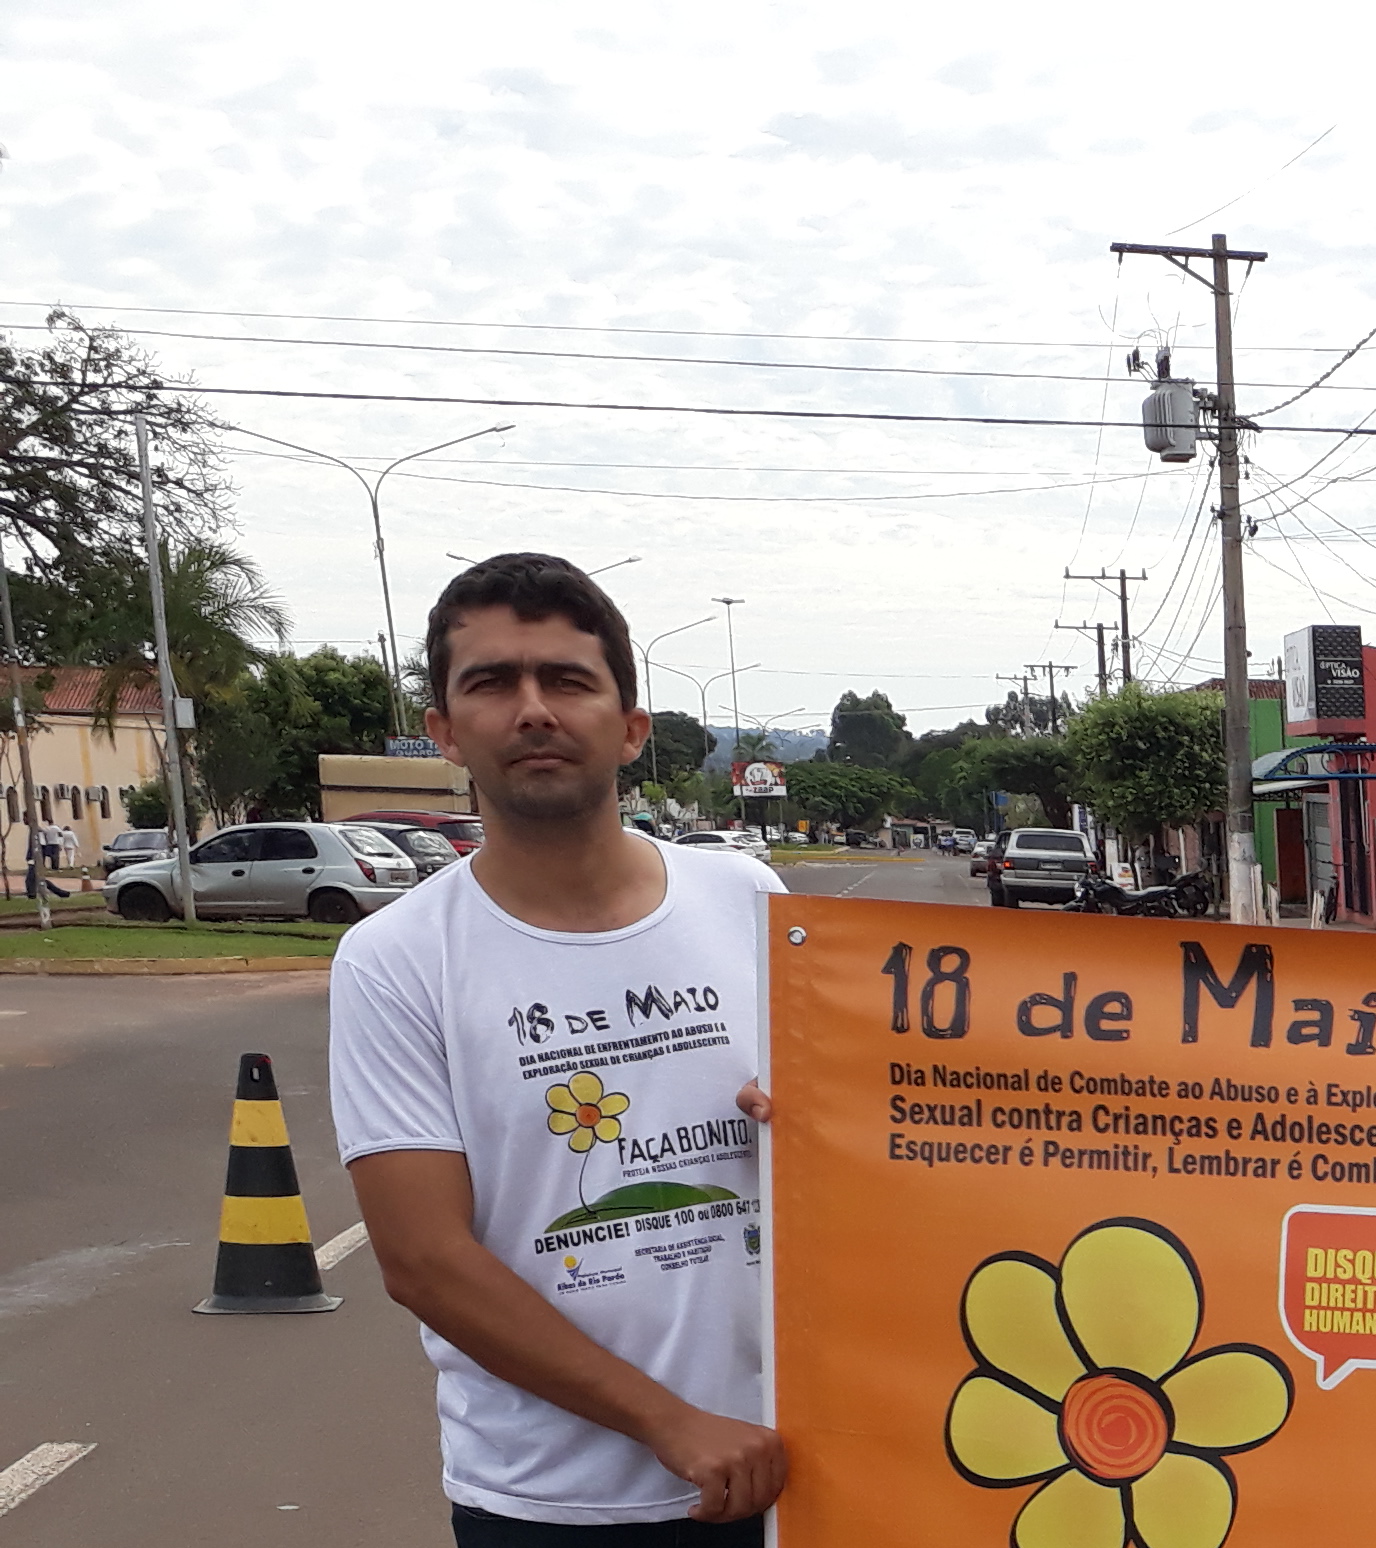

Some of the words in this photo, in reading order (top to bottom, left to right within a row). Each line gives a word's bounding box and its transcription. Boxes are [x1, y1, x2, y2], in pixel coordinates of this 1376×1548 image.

[508, 1003, 555, 1046] 18
[564, 1010, 610, 1034] DE
[626, 985, 719, 1027] MAIO
[881, 941, 970, 1039] 18
[1017, 972, 1132, 1041] de
[890, 1063, 926, 1086] Dia
[933, 1065, 1029, 1091] Nacional
[1036, 1070, 1063, 1093] de
[1070, 1071, 1170, 1098] Combate
[1177, 1082, 1203, 1099] ao
[1209, 1078, 1279, 1103] Abuso
[1286, 1087, 1298, 1104] e
[1306, 1081, 1318, 1105] à
[890, 1095, 982, 1127] Sexual
[992, 1103, 1082, 1132] contra
[1092, 1104, 1218, 1145] Crianças
[1227, 1118, 1242, 1140] e
[618, 1133, 676, 1165] FAÇA
[889, 1133, 1012, 1168] Esquecer
[1019, 1138, 1034, 1166] é
[1043, 1140, 1157, 1178] Permitir,
[1168, 1147, 1281, 1178] Lembrar
[1288, 1151, 1302, 1180] é
[535, 1222, 630, 1254] DENUNCIE!
[636, 1212, 671, 1232] DISQUE
[674, 1209, 694, 1225] 100
[712, 1204, 733, 1219] 0800
